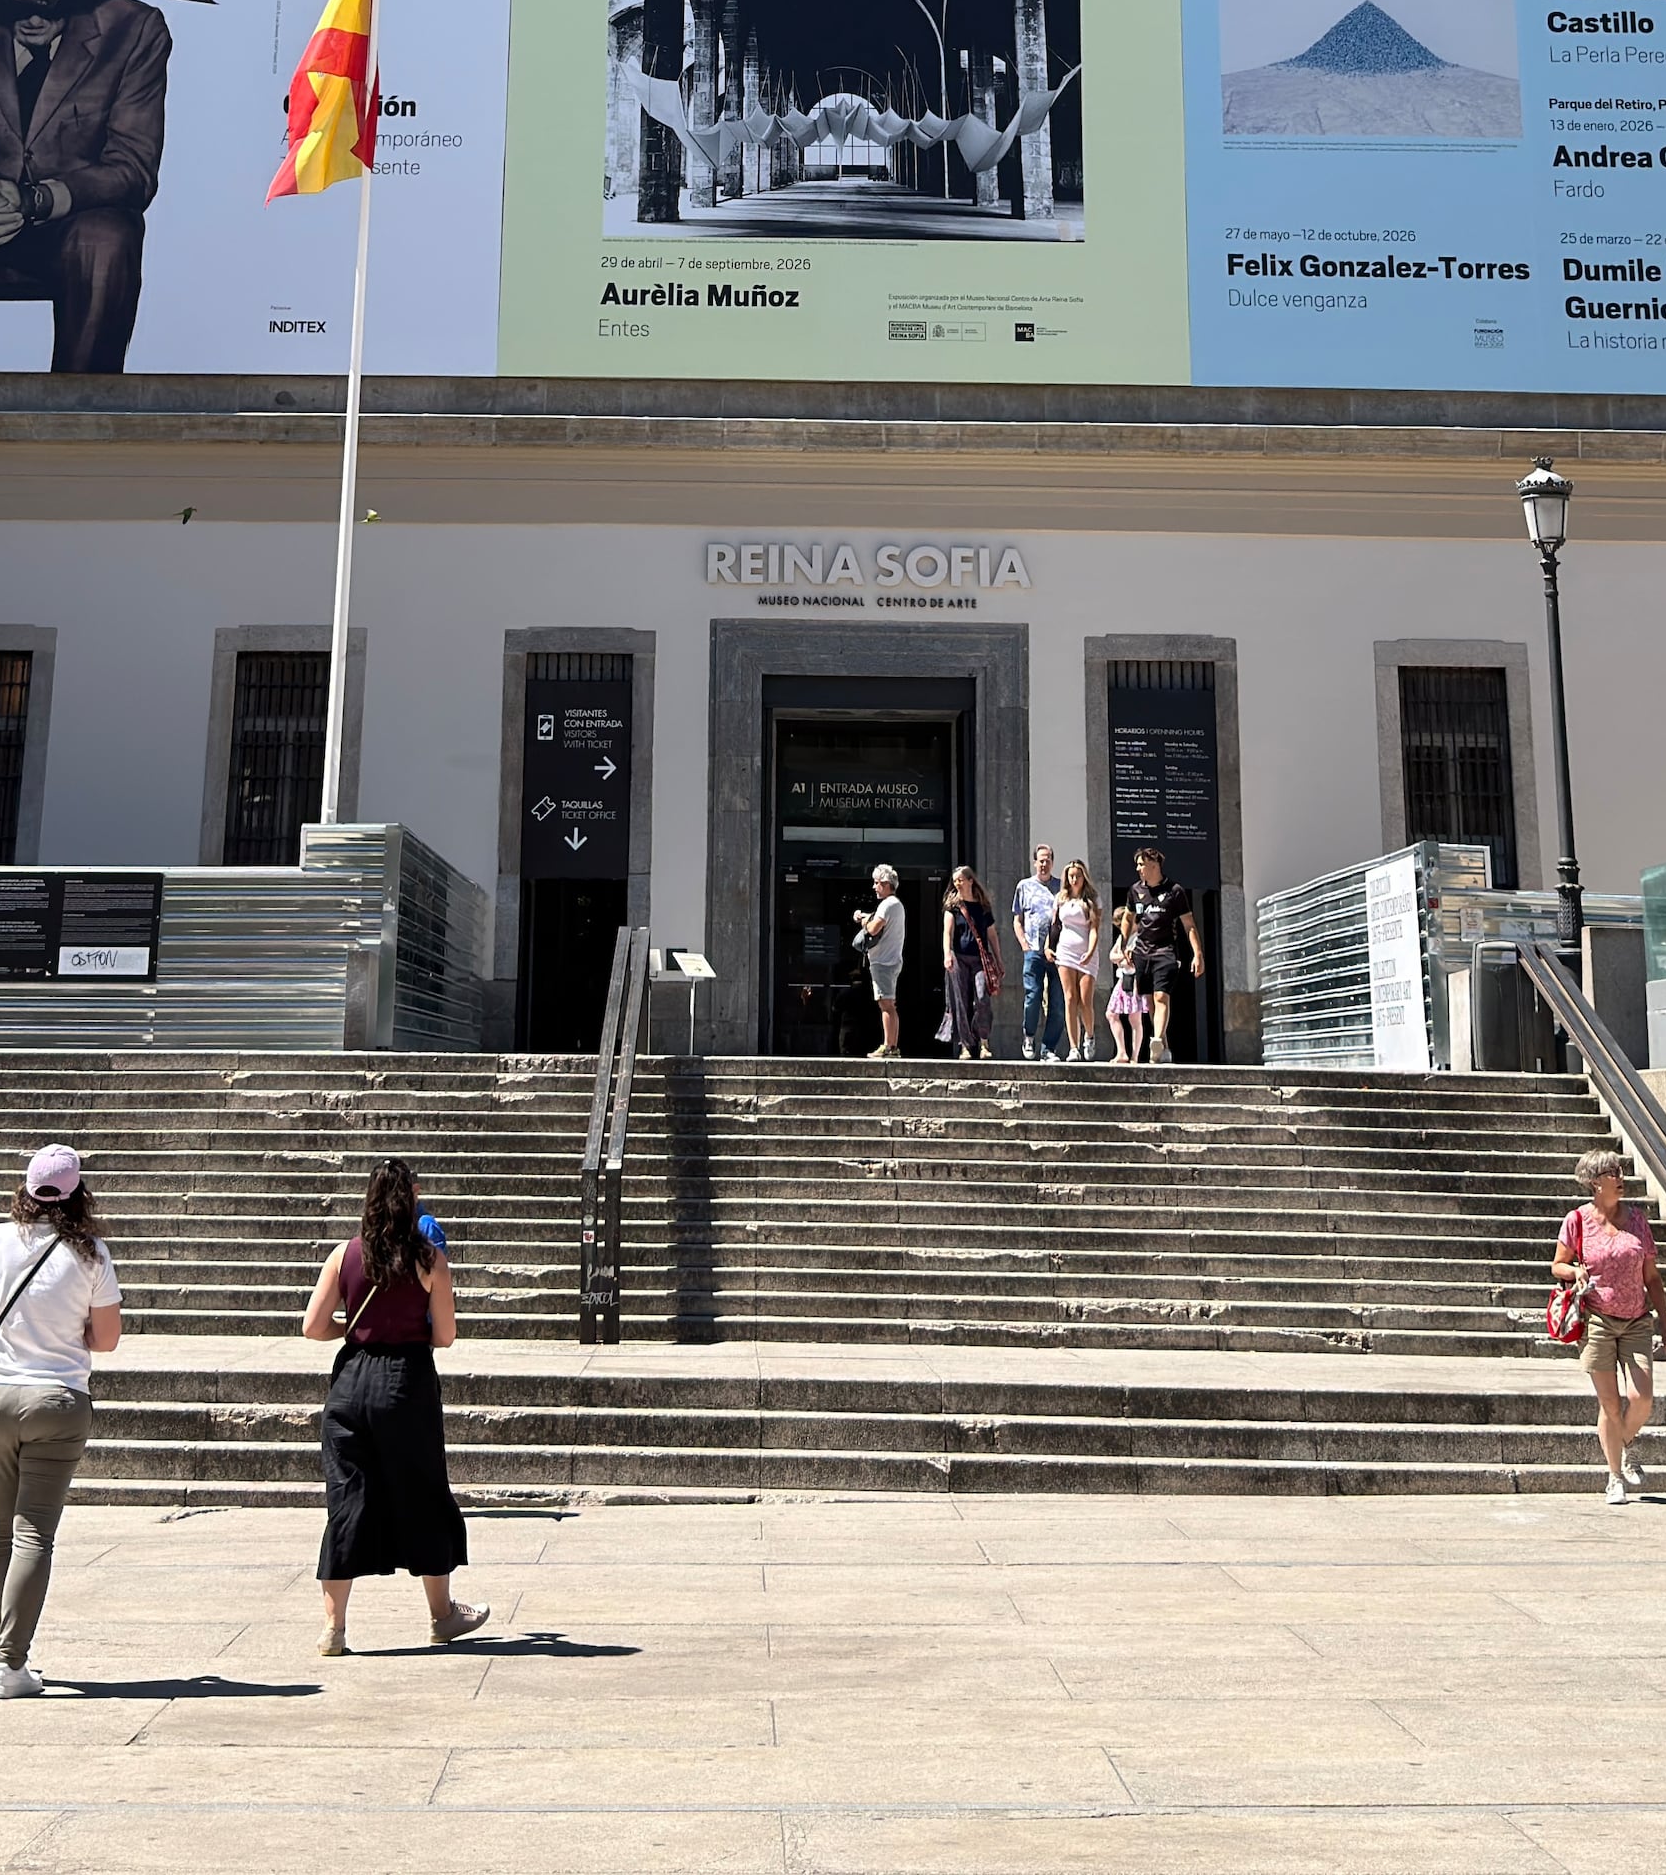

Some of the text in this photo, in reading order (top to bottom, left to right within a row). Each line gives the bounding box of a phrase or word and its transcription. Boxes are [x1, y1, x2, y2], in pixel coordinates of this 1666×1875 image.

[1547, 11, 1654, 34] Castillo
[1549, 46, 1571, 63] La
[1576, 45, 1620, 63] Perla
[1549, 98, 1592, 112] Parque
[1594, 98, 1613, 109] del
[1615, 99, 1656, 111] Retiro,
[1550, 119, 1565, 131] 13
[1567, 119, 1581, 131] de
[1583, 122, 1617, 132] enero,
[1620, 120, 1654, 132] 2026
[1553, 145, 1653, 168] Andrea
[1554, 179, 1605, 198] Fardo
[1225, 227, 1240, 239] 27
[1243, 228, 1257, 240] de
[1259, 231, 1290, 243] mayo
[1317, 229, 1332, 241] de
[1334, 229, 1380, 242] octubre,
[1382, 229, 1416, 242] 2026
[1560, 232, 1577, 244] 25
[1579, 233, 1594, 245] de
[1596, 236, 1631, 245] marzo
[1645, 233, 1662, 245] 22
[601, 256, 618, 268] 29
[621, 256, 635, 268] de
[638, 257, 663, 269] abril
[678, 257, 685, 269] 7
[688, 257, 703, 269] de
[705, 258, 773, 272] septiembre,
[777, 258, 811, 270] 2026
[1227, 253, 1530, 280] Felix Gonzalez-Torres
[1563, 258, 1661, 282] Dumile
[600, 282, 799, 307] Aurèlia Muñoz
[1228, 288, 1367, 312] Dulce venganza
[269, 321, 326, 333] INDITEX
[599, 319, 650, 337] Entes
[1567, 331, 1589, 349] La
[1593, 331, 1657, 349] historia
[707, 543, 1032, 588] REINA SOFIA
[758, 596, 977, 609] MUSEO NACIONAL CENTRO DE ARTE
[564, 720, 623, 728] CON ENTRADA
[564, 730, 597, 738] VISITORS
[563, 740, 613, 749] WITH TICKET
[791, 783, 918, 795] A1 ENTRADA MUSEO
[561, 801, 603, 809] TAQUILLAS
[819, 798, 934, 810] MUSEUM ENTRANCE
[561, 811, 616, 819] TICKET OFFICE
